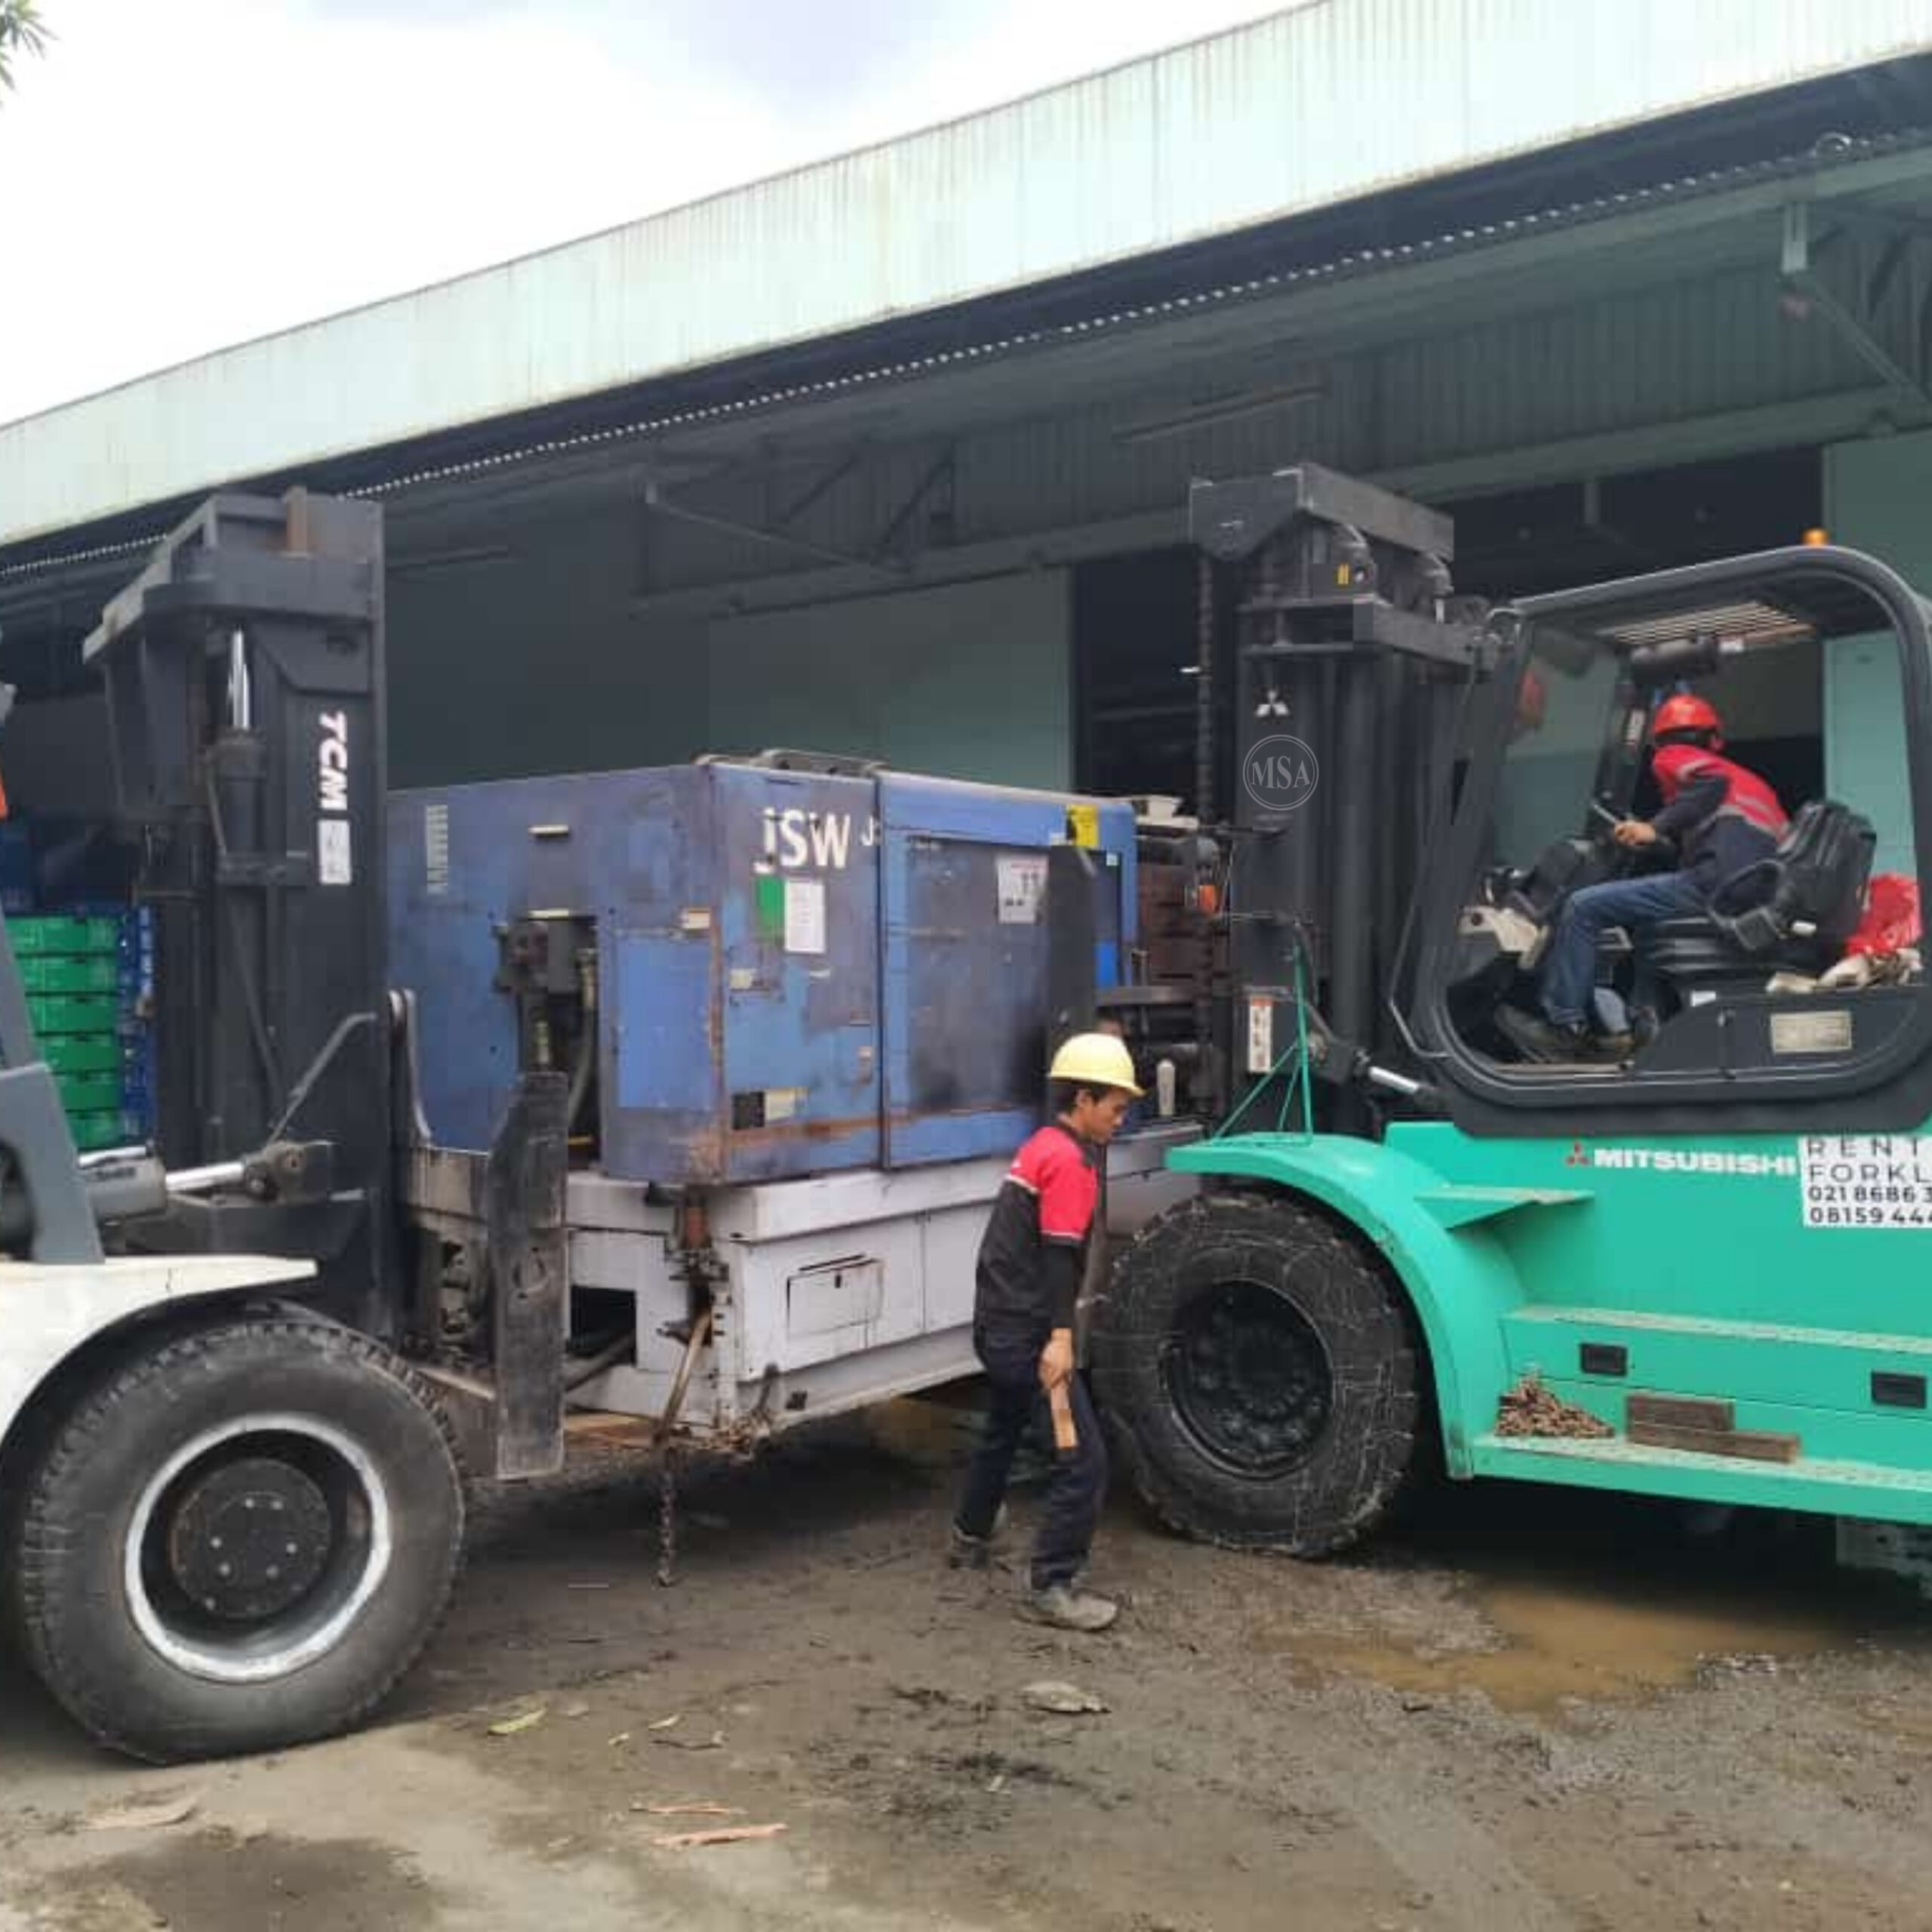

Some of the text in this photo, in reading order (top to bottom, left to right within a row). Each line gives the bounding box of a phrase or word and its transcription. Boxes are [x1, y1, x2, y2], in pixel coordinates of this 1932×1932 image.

[320, 712, 348, 810] TCM
[1594, 1149, 1796, 1175] MITSUBISHI
[1810, 1164, 1932, 1183] FORKL
[1810, 1207, 1883, 1223] 08159
